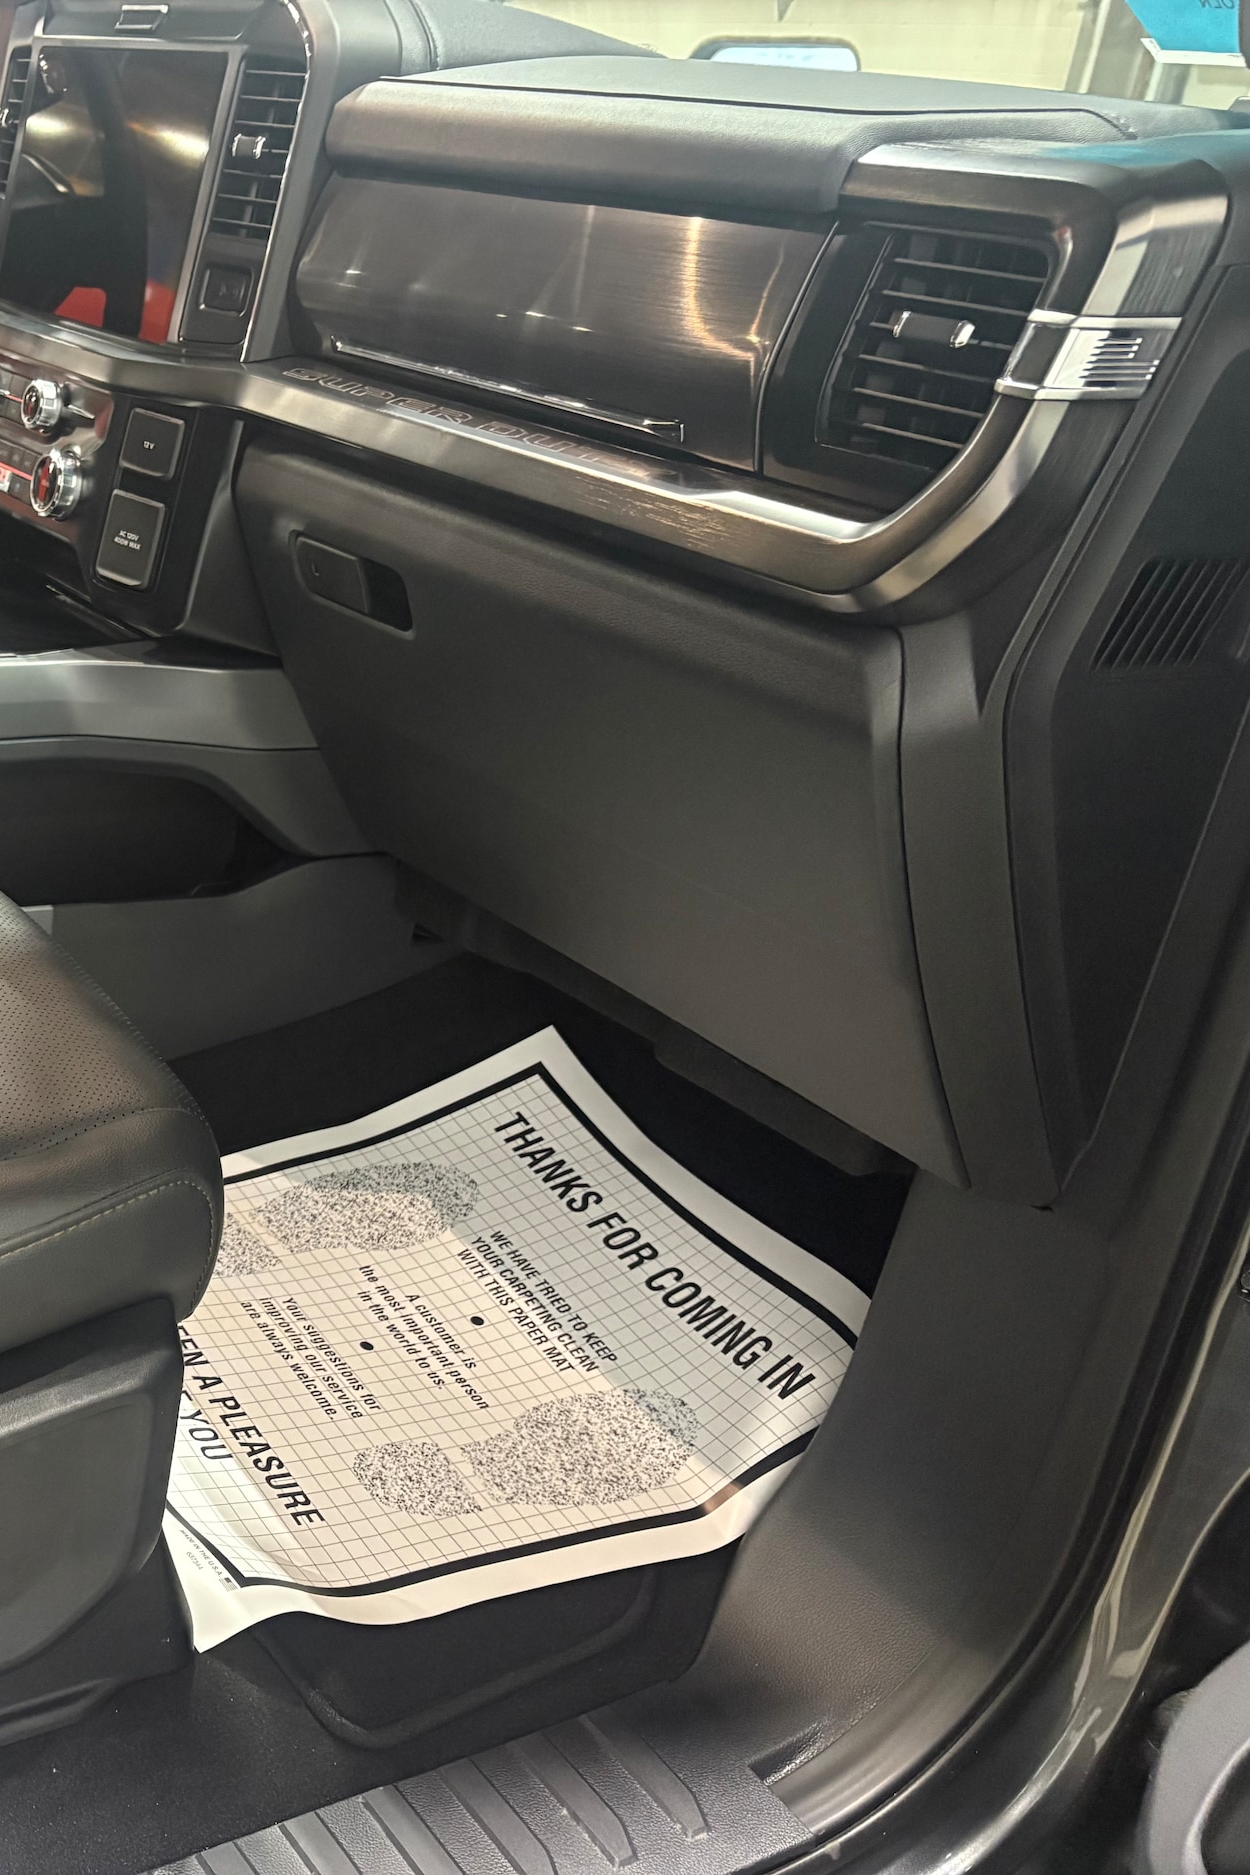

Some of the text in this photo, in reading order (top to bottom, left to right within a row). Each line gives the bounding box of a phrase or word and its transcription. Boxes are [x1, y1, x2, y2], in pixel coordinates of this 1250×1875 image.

[283, 368, 678, 480] SUPER DUTY
[129, 540, 141, 550] MAX
[457, 1249, 575, 1372] WITH THIS PAPER MAT
[471, 1236, 599, 1372] YOUR CARPETING CLEAN
[490, 1230, 618, 1362] WE HAVE TRIED TO KEEP
[494, 1111, 816, 1400] THANKS FOR COMING IN
[241, 1301, 337, 1420] are always welcome.
[259, 1297, 363, 1418] improving our service
[282, 1297, 382, 1411] Your suggestions for
[357, 1291, 445, 1390] in the world to us.
[359, 1265, 490, 1409] the most important person
[405, 1294, 477, 1369] A customer is
[180, 1409, 233, 1460] YOU
[192, 1375, 223, 1390] A
[209, 1395, 326, 1526] PLEASURE
[199, 1550, 210, 1561] THE
